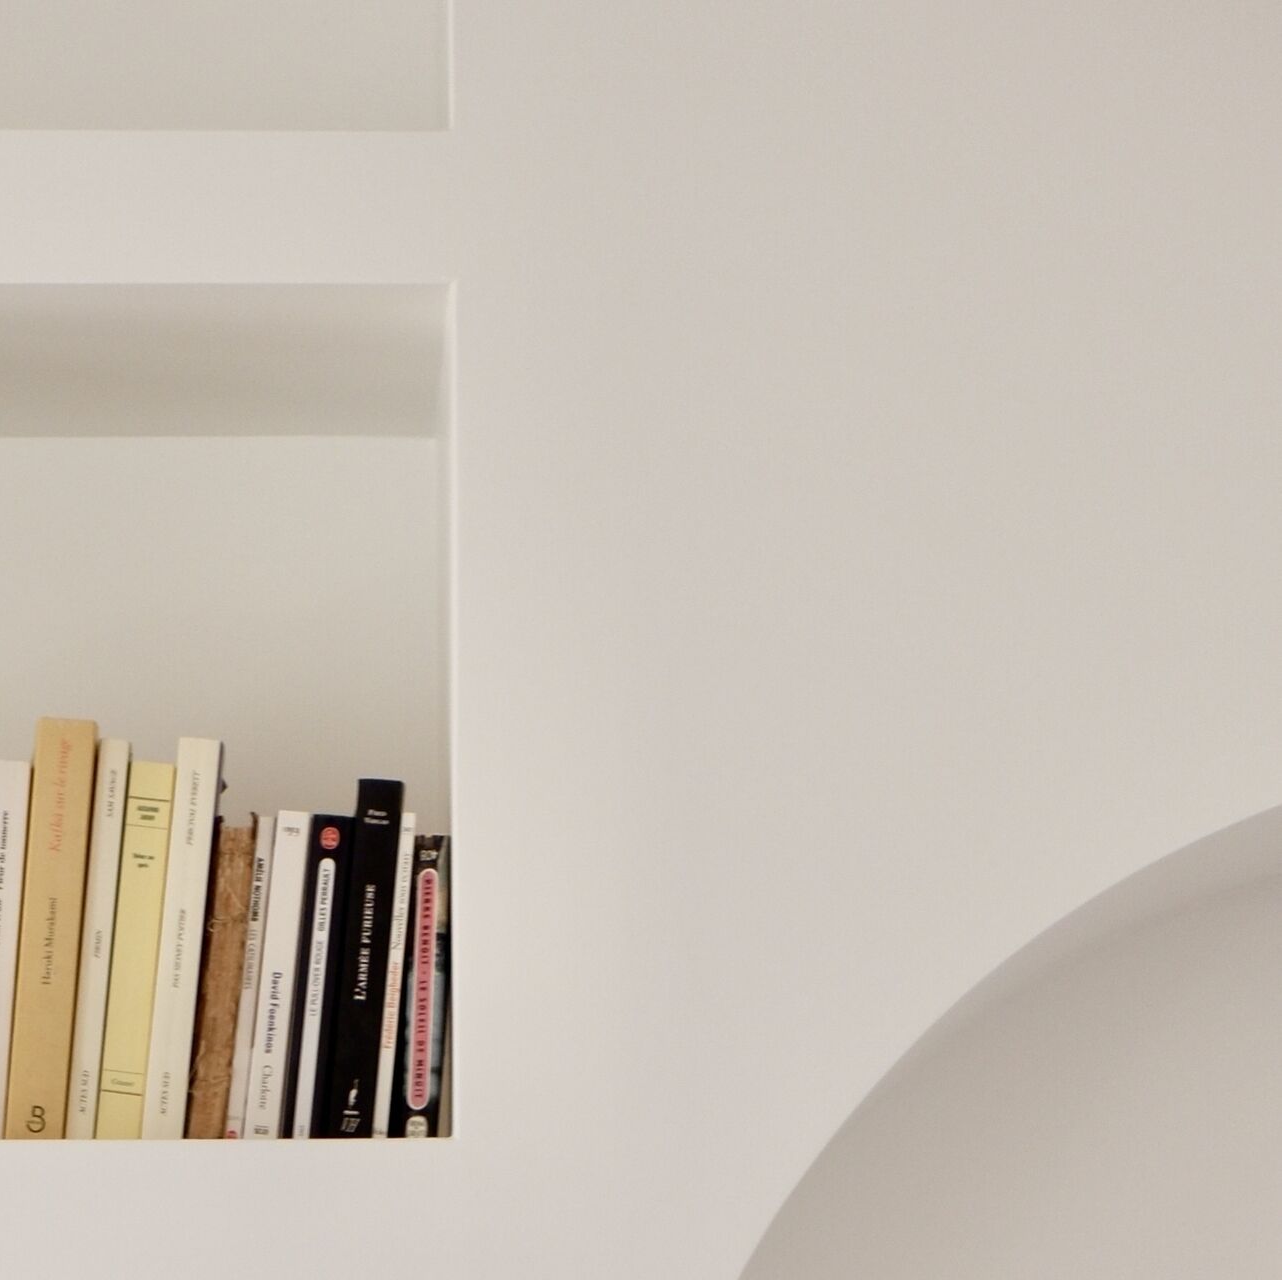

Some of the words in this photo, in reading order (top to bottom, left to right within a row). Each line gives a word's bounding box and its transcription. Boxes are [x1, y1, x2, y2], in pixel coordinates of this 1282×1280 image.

[251, 884, 264, 922] NOTHOMB
[319, 868, 330, 907] PERRAULT
[422, 878, 432, 919] PIERRE
[45, 897, 58, 950] Murakami
[361, 884, 377, 944] FURIEUSE
[41, 953, 54, 985] Haruki
[270, 972, 283, 1000] David
[419, 980, 428, 991] LE
[264, 1002, 280, 1054] Foenkinos
[417, 997, 427, 1034] SOLEIL
[416, 1039, 426, 1053] DE
[259, 1064, 273, 1111] Charlotte
[415, 1058, 424, 1098] MINUIT
